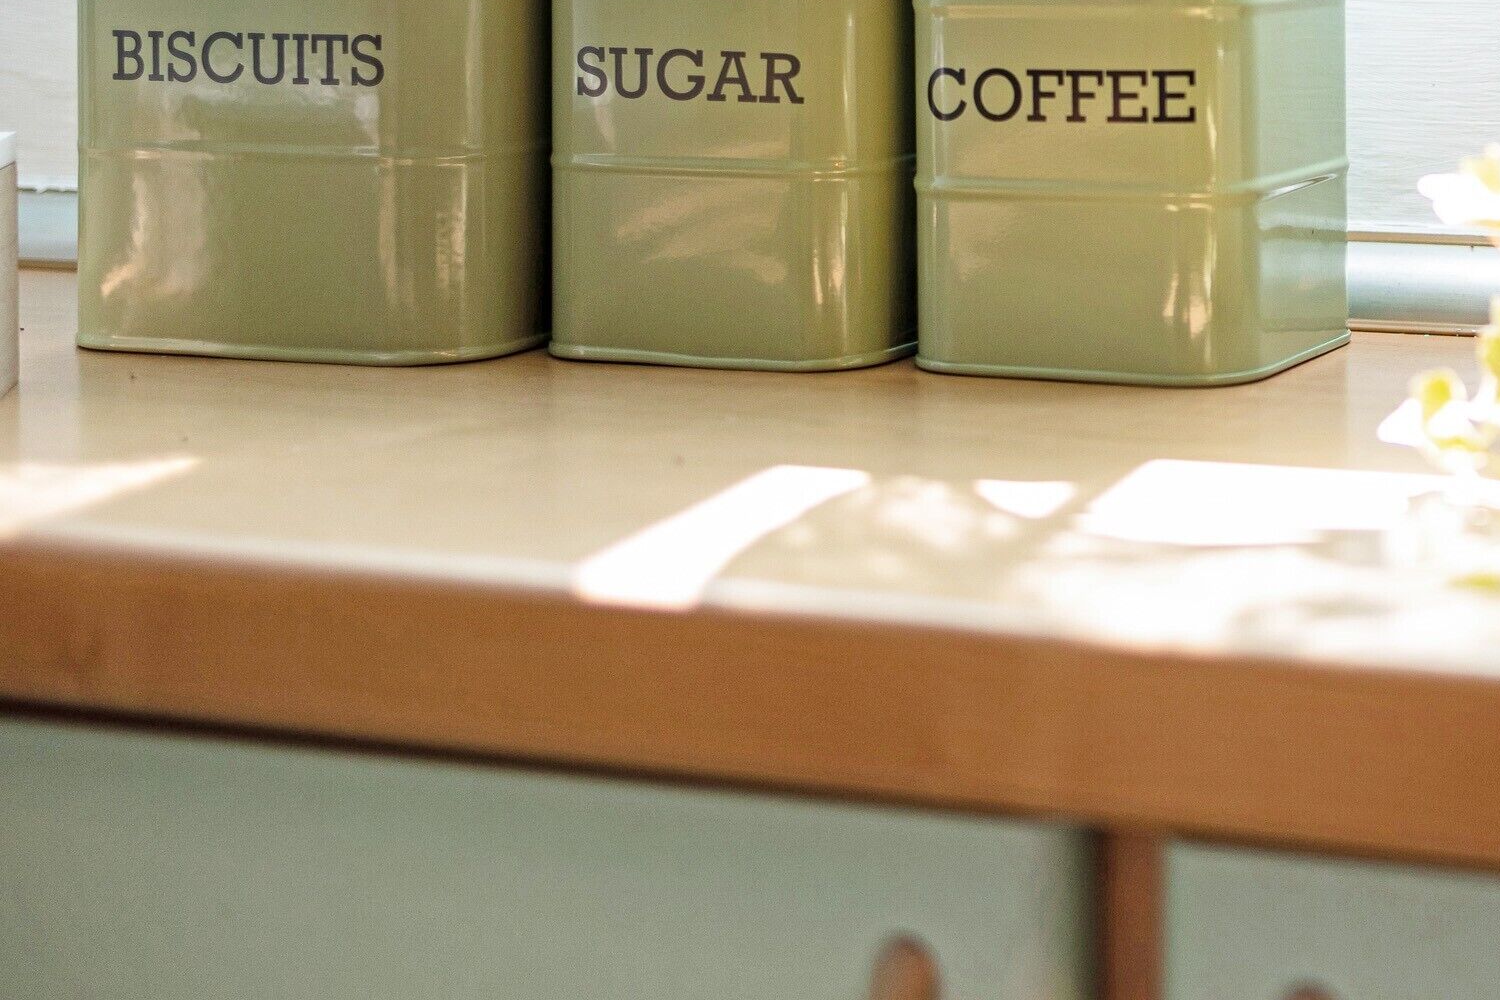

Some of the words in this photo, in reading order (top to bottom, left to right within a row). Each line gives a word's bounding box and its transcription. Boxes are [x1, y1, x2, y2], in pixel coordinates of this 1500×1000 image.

[112, 29, 385, 87] BISCUITS
[576, 45, 805, 105] SUGAR
[927, 67, 1197, 123] COFFEE
